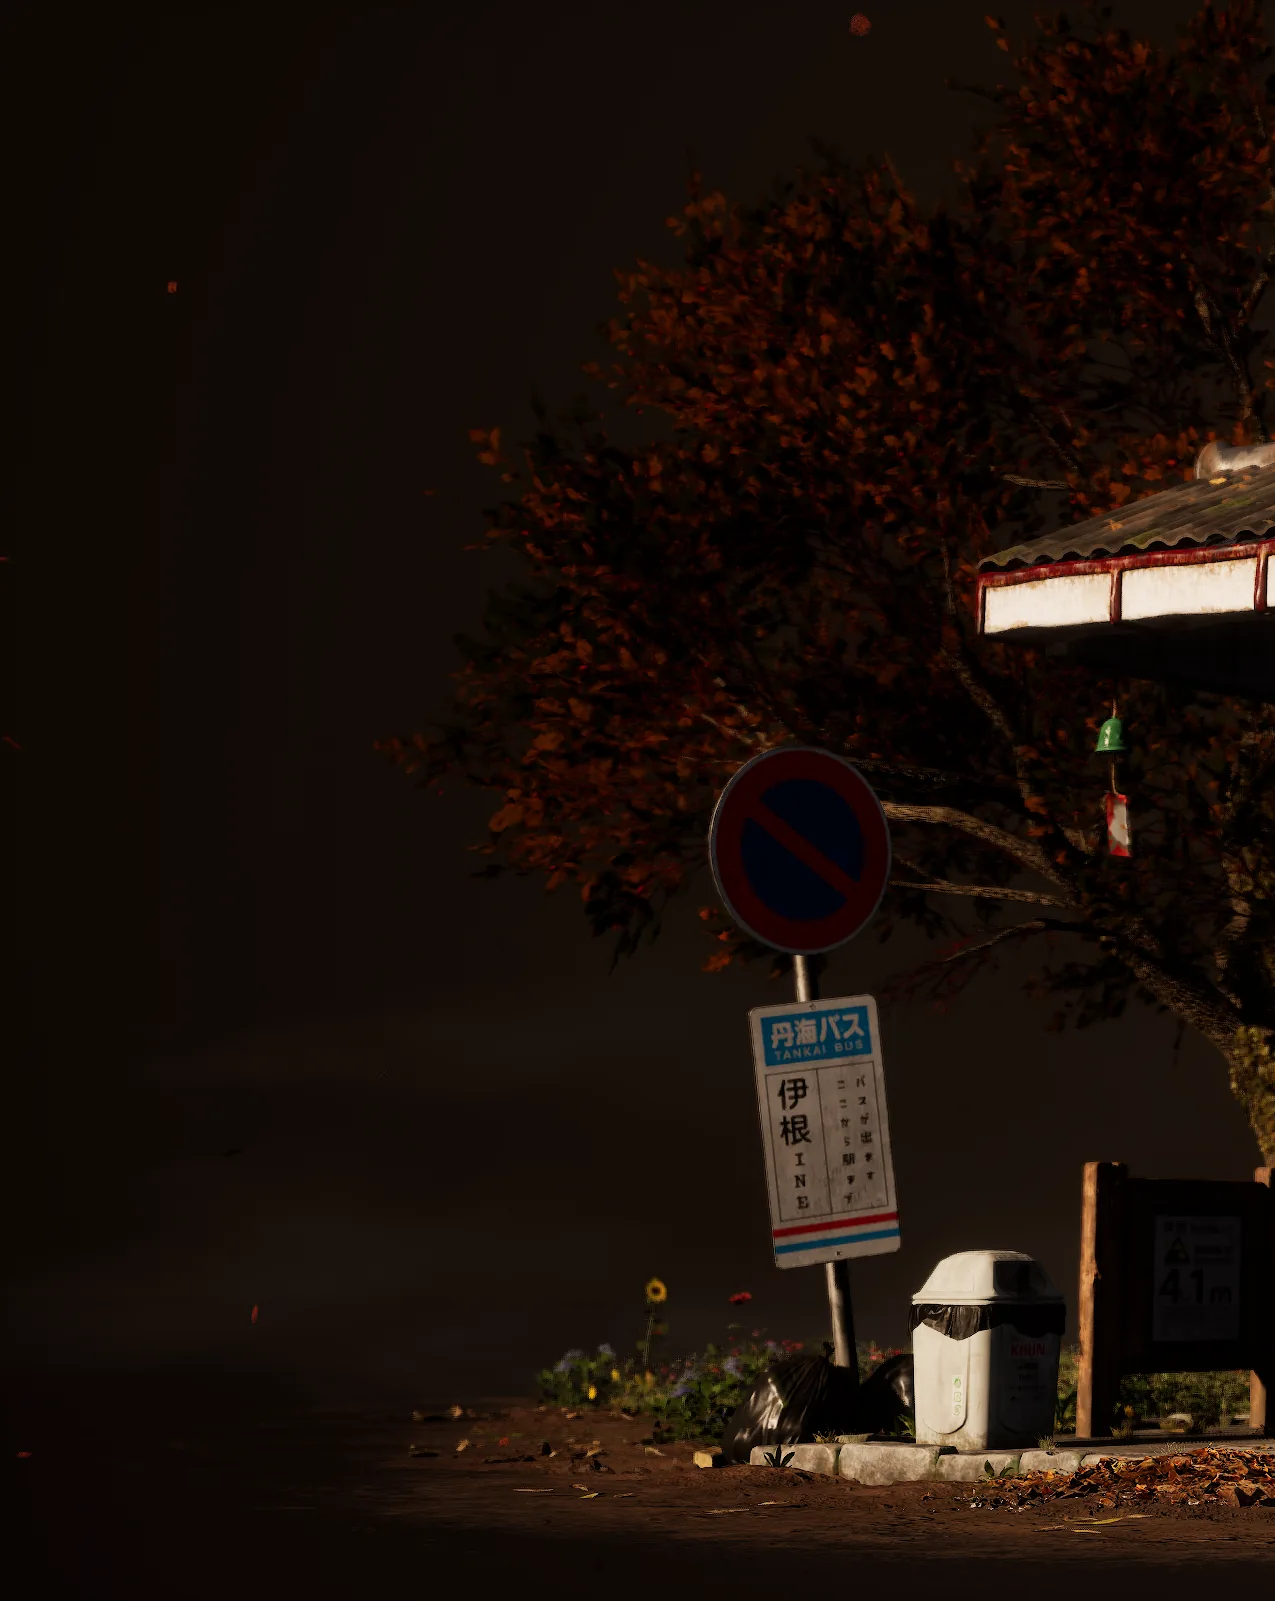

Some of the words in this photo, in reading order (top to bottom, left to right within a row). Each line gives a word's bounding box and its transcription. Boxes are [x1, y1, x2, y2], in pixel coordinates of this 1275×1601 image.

[771, 1013, 865, 1049] 丹海バス
[774, 1045, 827, 1061] TANKAI
[835, 1039, 863, 1053] BUS
[778, 1079, 812, 1146] 伊根
[795, 1152, 809, 1210] INE
[1010, 1342, 1046, 1357] KIRIN
